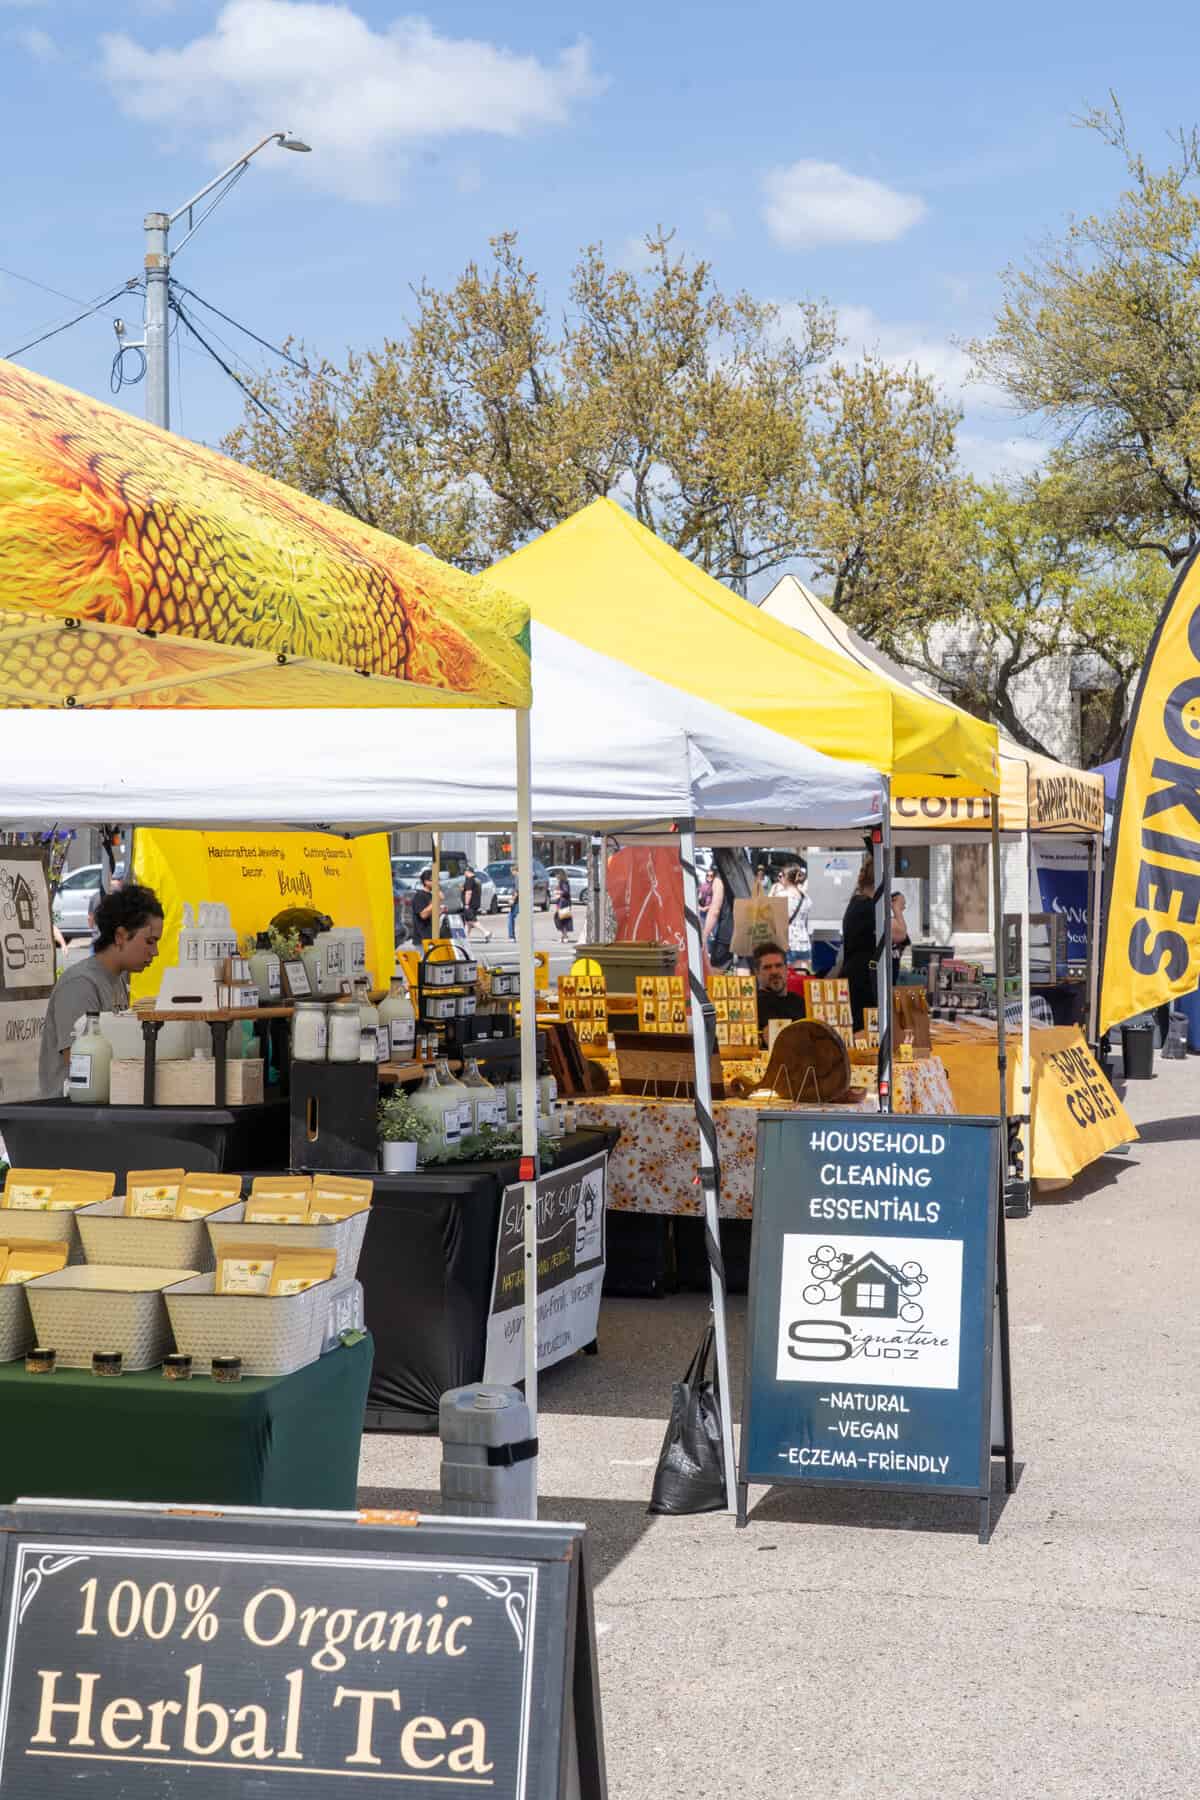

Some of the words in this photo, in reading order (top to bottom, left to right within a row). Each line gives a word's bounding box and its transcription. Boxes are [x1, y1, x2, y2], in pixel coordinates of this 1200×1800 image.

[1129, 602, 1200, 982] OKIES
[809, 1131, 946, 1154] HOUSEHOLD
[820, 1163, 932, 1187] CLEANING
[809, 1196, 941, 1223] ESSENTIALS
[820, 1392, 910, 1413] -NATURAL
[828, 1421, 899, 1440] -VEGAN
[778, 1448, 950, 1475] -ECZEMA-FRIENDLY
[75, 1576, 222, 1642] 100%
[243, 1586, 474, 1673] Organic
[30, 1663, 305, 1761] Herbal
[332, 1685, 495, 1774] Tea
